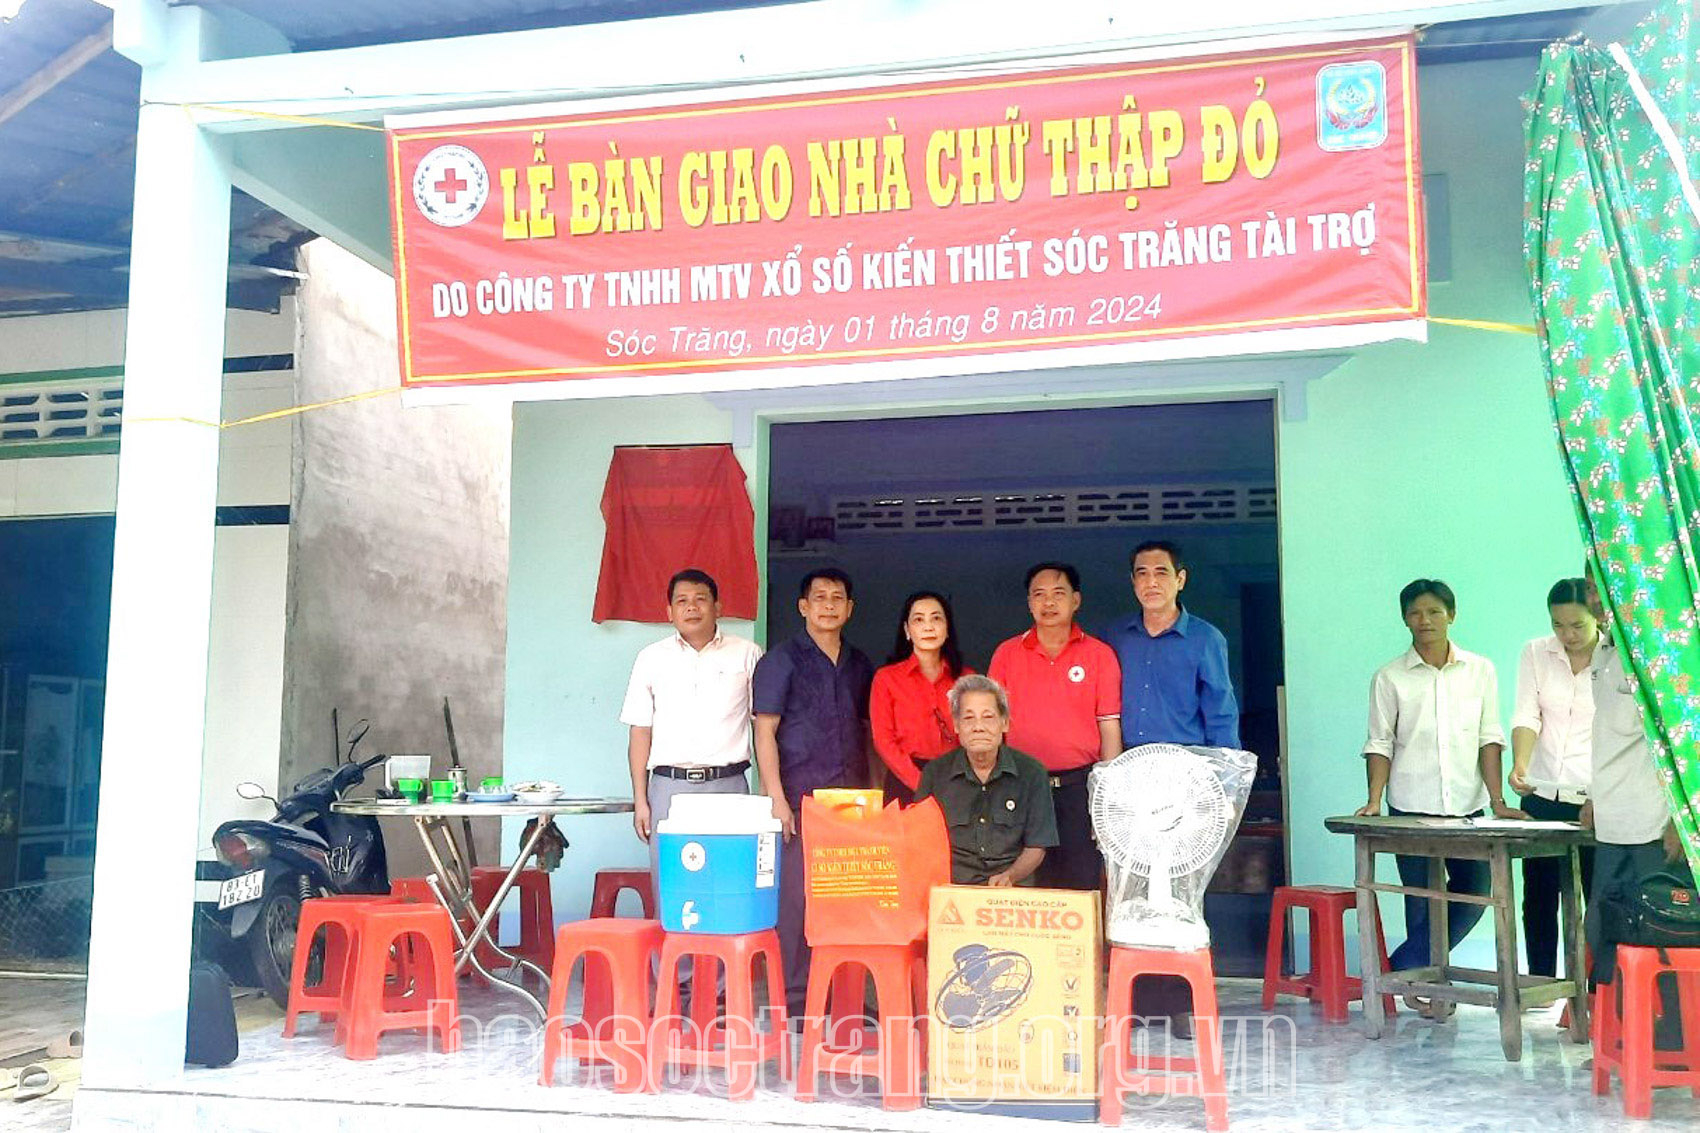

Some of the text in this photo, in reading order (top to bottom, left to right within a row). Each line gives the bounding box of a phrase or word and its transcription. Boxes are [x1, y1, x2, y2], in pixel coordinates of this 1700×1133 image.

[500, 76, 1280, 240] LỄ BÀN GIAO NHÀ CHỮ THẬP ĐỎ
[432, 202, 1375, 318] DO CÔNG TY TNHH MTV XỔ SỐ KIẾN THIẾT SÓC TRĂNG TÀI TRỢ
[606, 293, 1162, 358] Sóc Trăng, ngày 01 tháng 8 năm 2024
[975, 908, 1085, 930] SENKO
